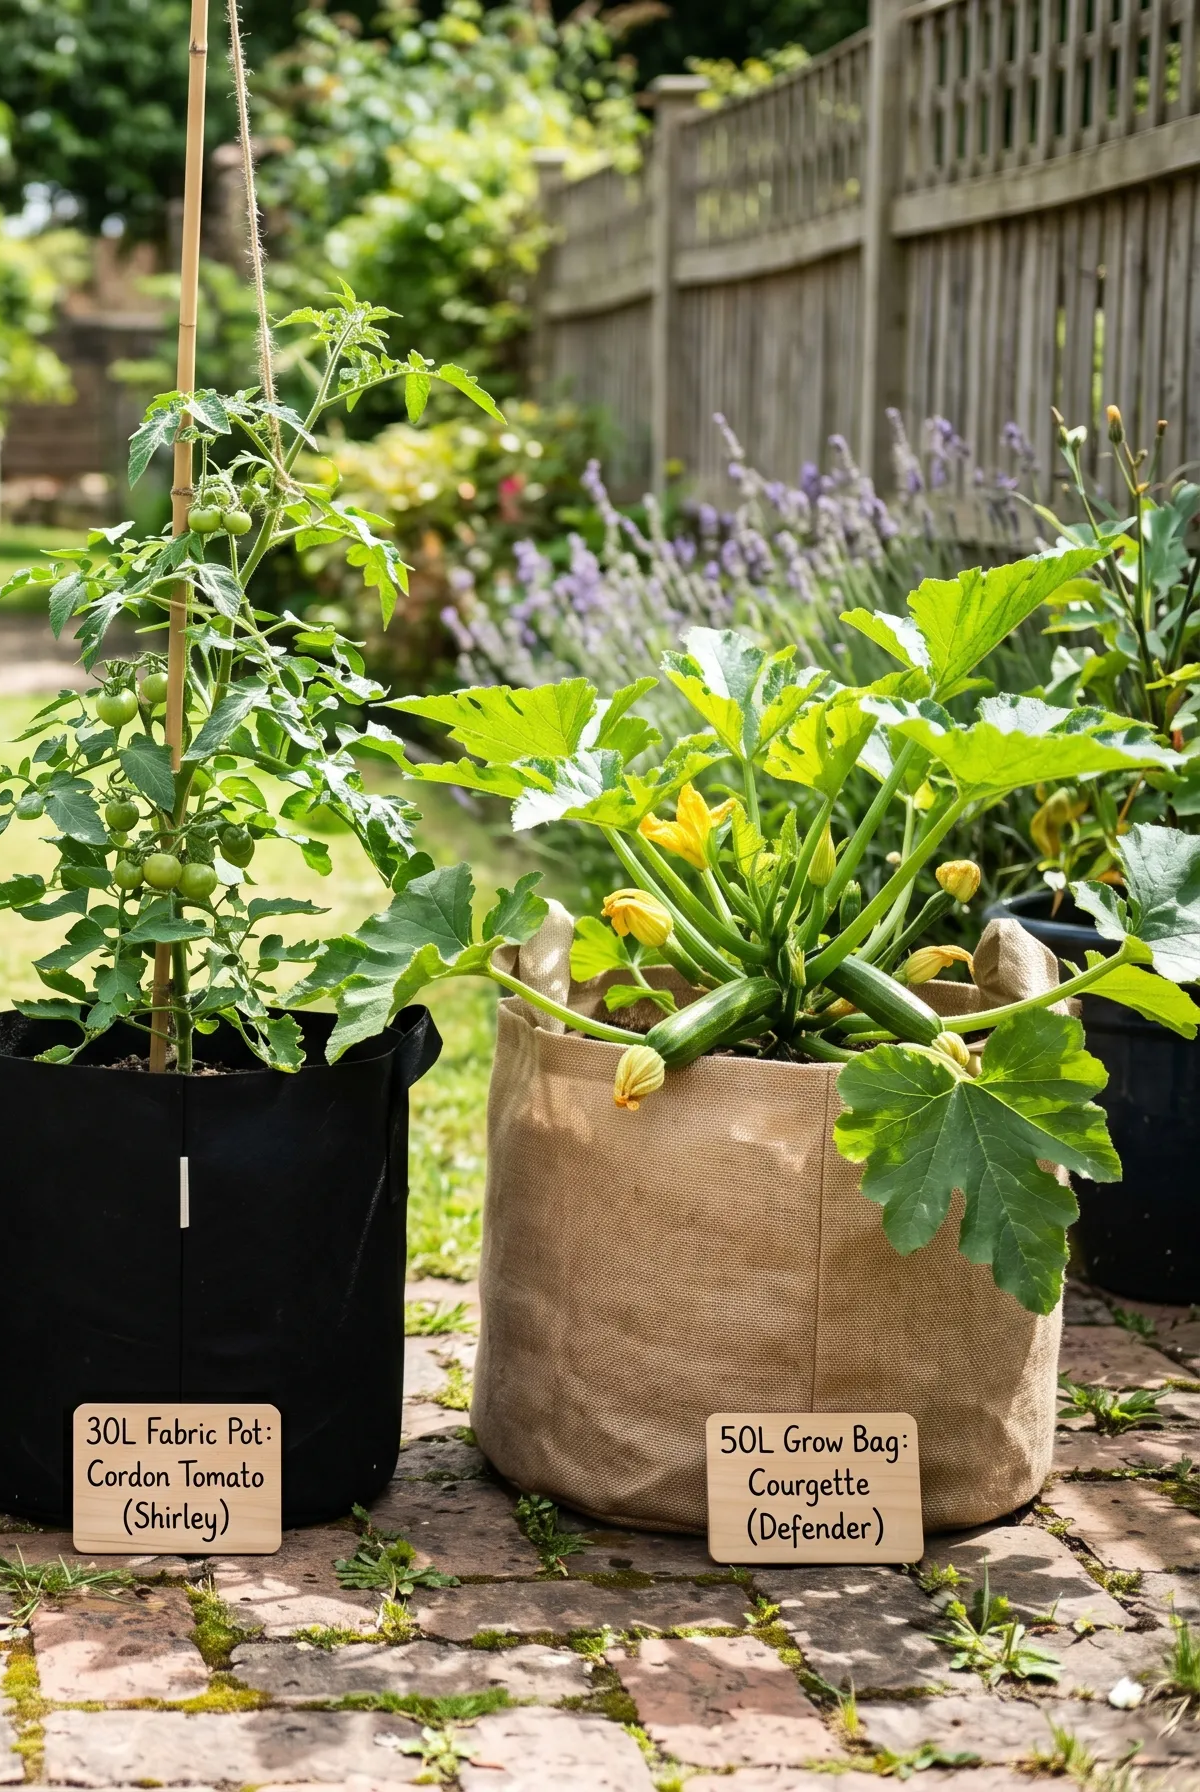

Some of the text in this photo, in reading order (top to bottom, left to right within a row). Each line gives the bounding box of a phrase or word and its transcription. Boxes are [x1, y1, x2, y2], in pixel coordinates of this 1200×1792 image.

[86, 1416, 272, 1446] 30L Fabric Pot:
[720, 1424, 908, 1464] 50L Grow Bag:
[87, 1458, 265, 1489] Cordon Tomato
[748, 1467, 871, 1508] Courgette
[123, 1497, 230, 1543] (Shirley)
[747, 1506, 884, 1549] (Defender)
